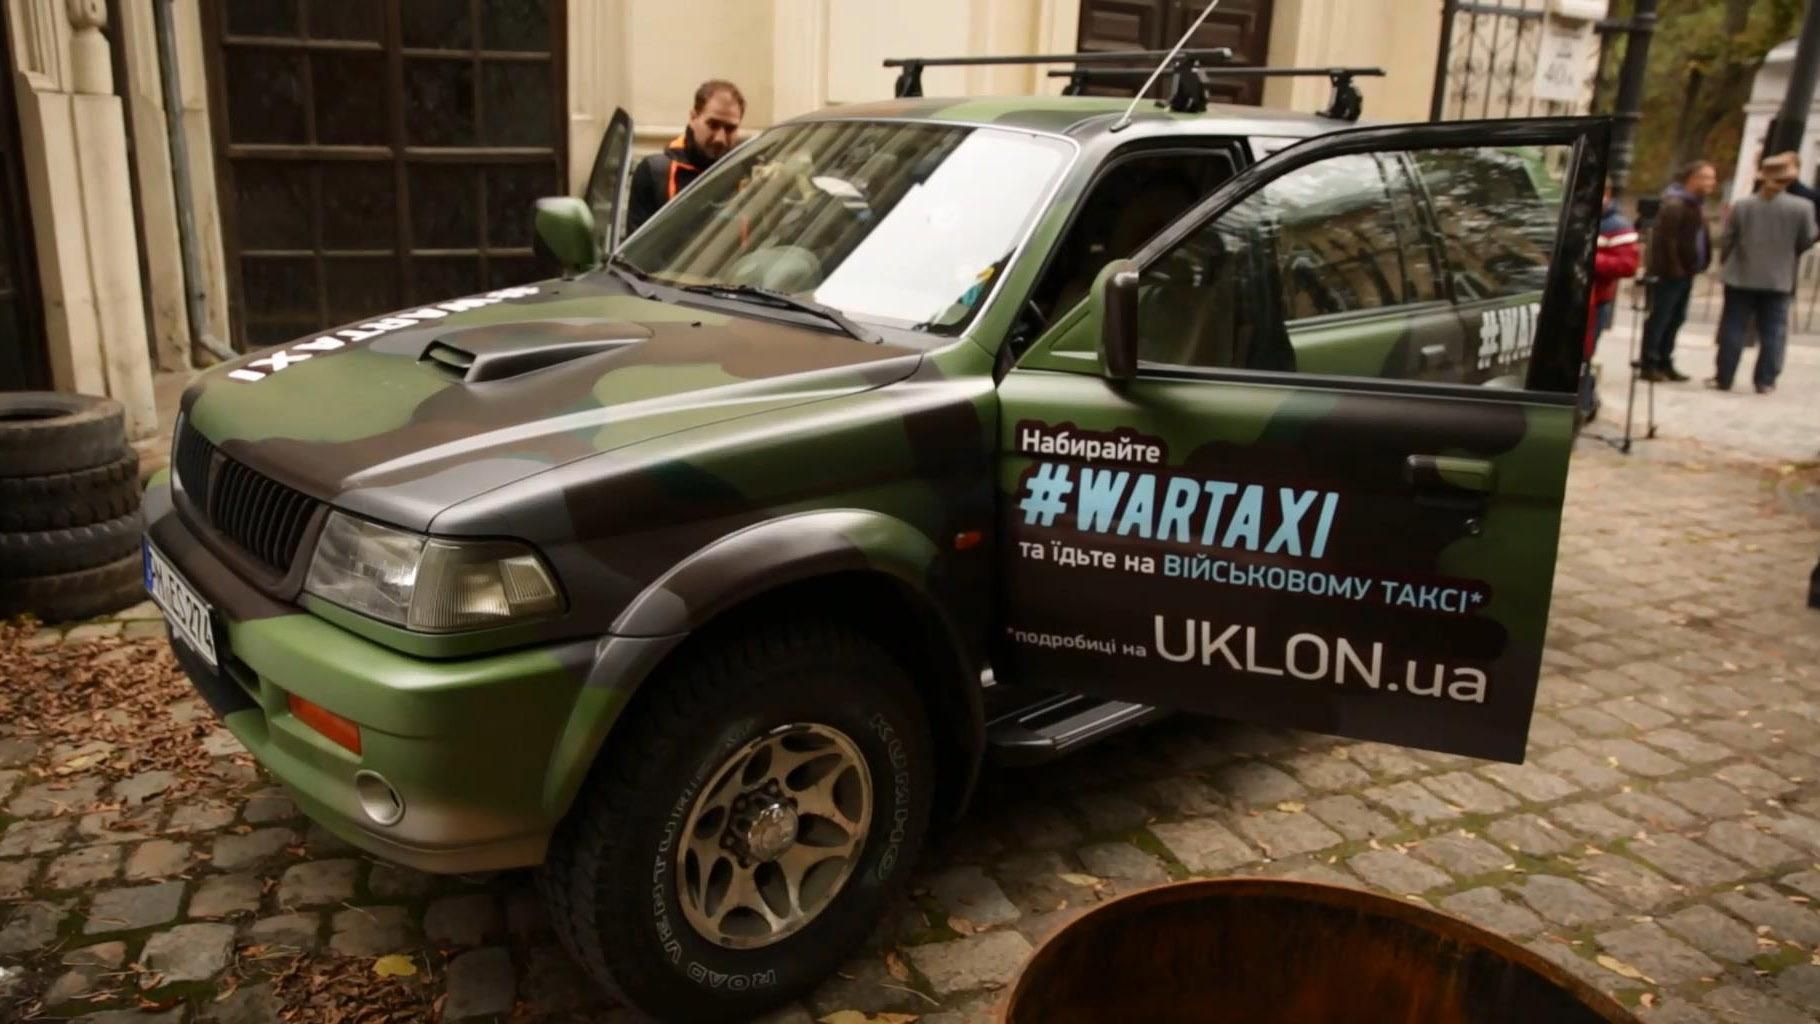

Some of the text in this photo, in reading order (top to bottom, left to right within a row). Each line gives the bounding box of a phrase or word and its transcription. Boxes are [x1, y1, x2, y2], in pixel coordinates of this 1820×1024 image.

[1021, 428, 1161, 463] Набирайте
[1019, 461, 1340, 559] #WARTAXI
[1019, 541, 1045, 561] та
[1051, 540, 1117, 568] їдьте
[1124, 554, 1156, 574] на
[1163, 553, 1373, 600] ВІЙСЬКОВОМУ
[1122, 643, 1148, 658] на
[1154, 614, 1488, 704] UKLON.ua
[686, 961, 777, 991] ROAD
